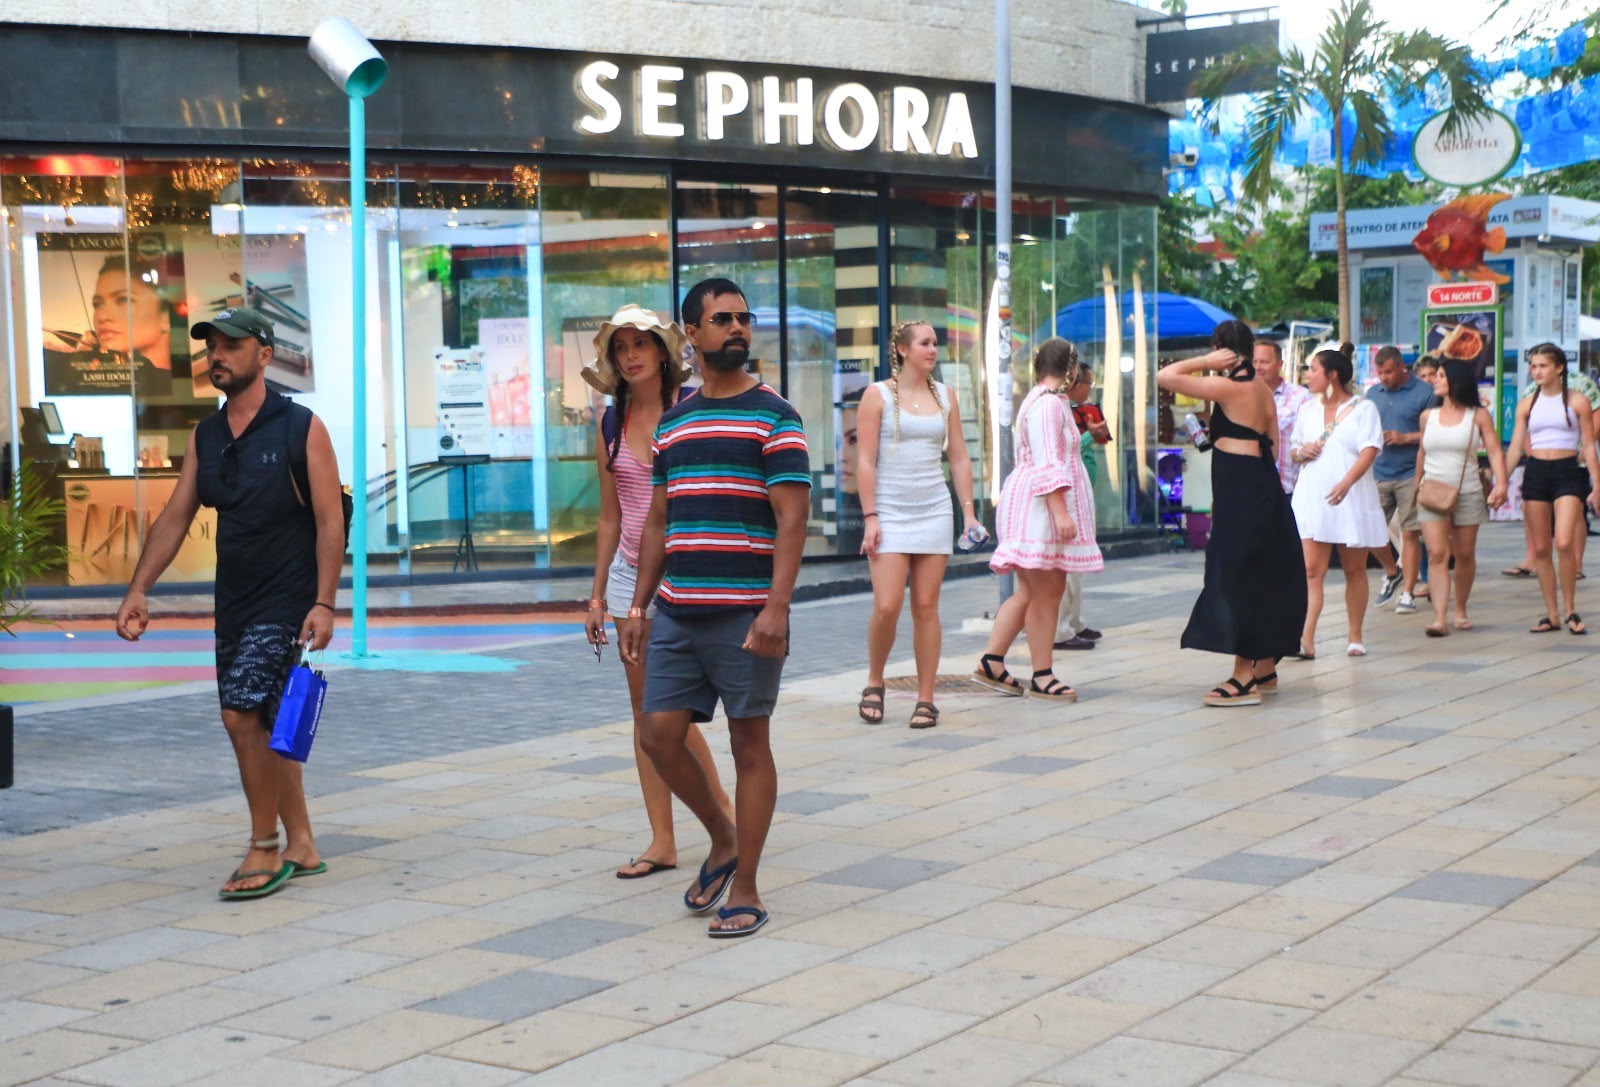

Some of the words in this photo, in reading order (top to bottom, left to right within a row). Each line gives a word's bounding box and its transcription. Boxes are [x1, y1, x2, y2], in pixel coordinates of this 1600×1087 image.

[575, 60, 978, 158] SEPHORA
[1385, 222, 1398, 233] DE
[1440, 293, 1450, 303] 14
[1451, 290, 1483, 301] NORTE
